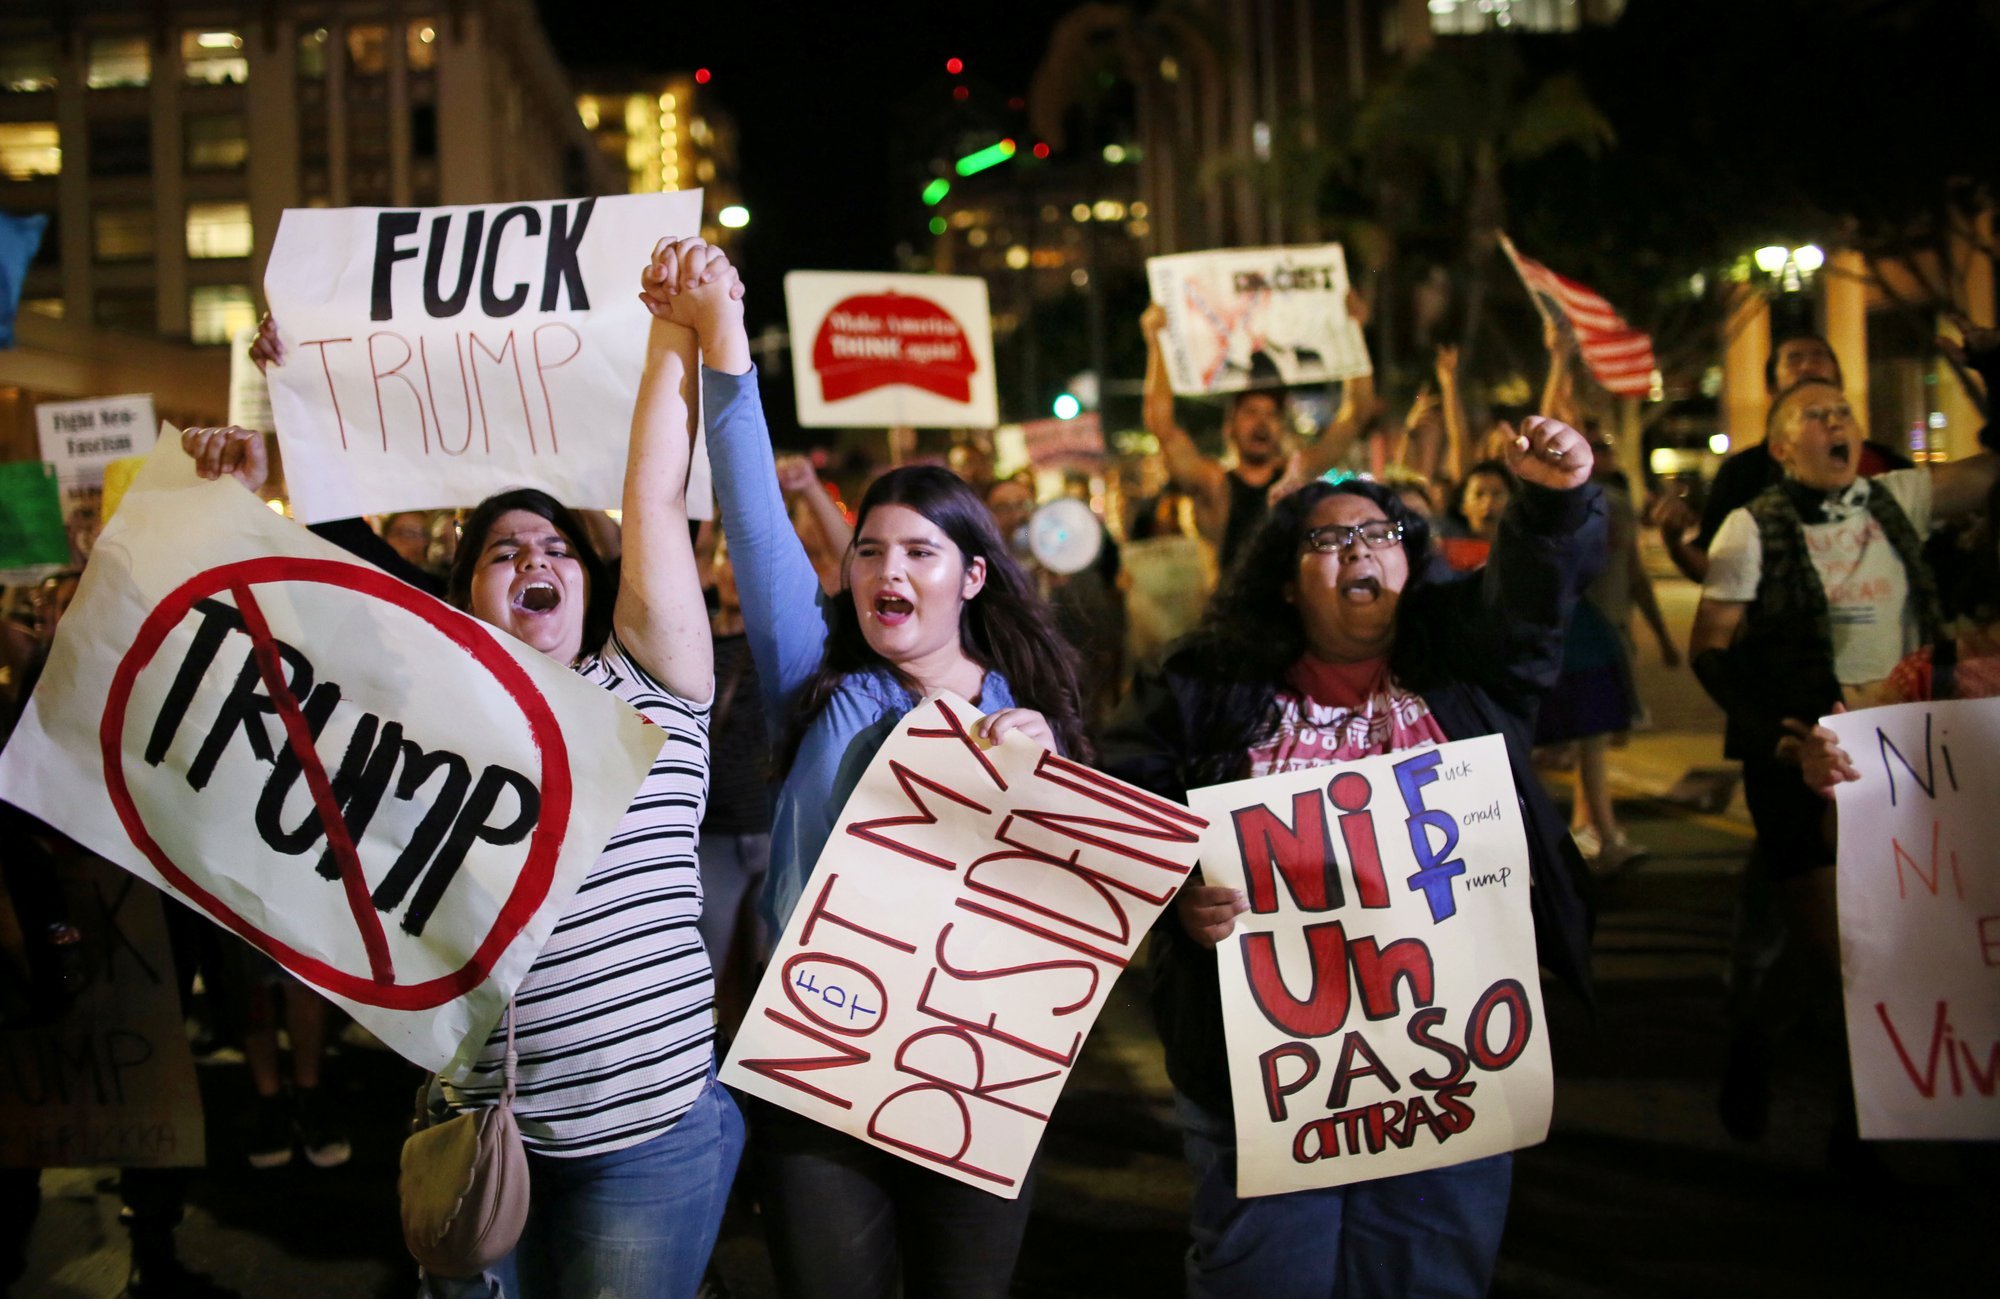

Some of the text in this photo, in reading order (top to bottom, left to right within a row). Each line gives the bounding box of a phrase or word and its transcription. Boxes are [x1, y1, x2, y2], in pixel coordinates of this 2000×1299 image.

[370, 196, 598, 320] FUCK
[300, 322, 582, 456] TRUMP
[831, 336, 899, 359] THINK
[144, 597, 541, 937] TRUMP
[1876, 712, 1959, 807] Ni
[738, 699, 1009, 1110] NOT MY
[1231, 771, 1391, 914] Ni
[867, 749, 1210, 1187] PRESIDENT
[1240, 920, 1434, 1039] Un
[1258, 978, 1532, 1122] PASO
